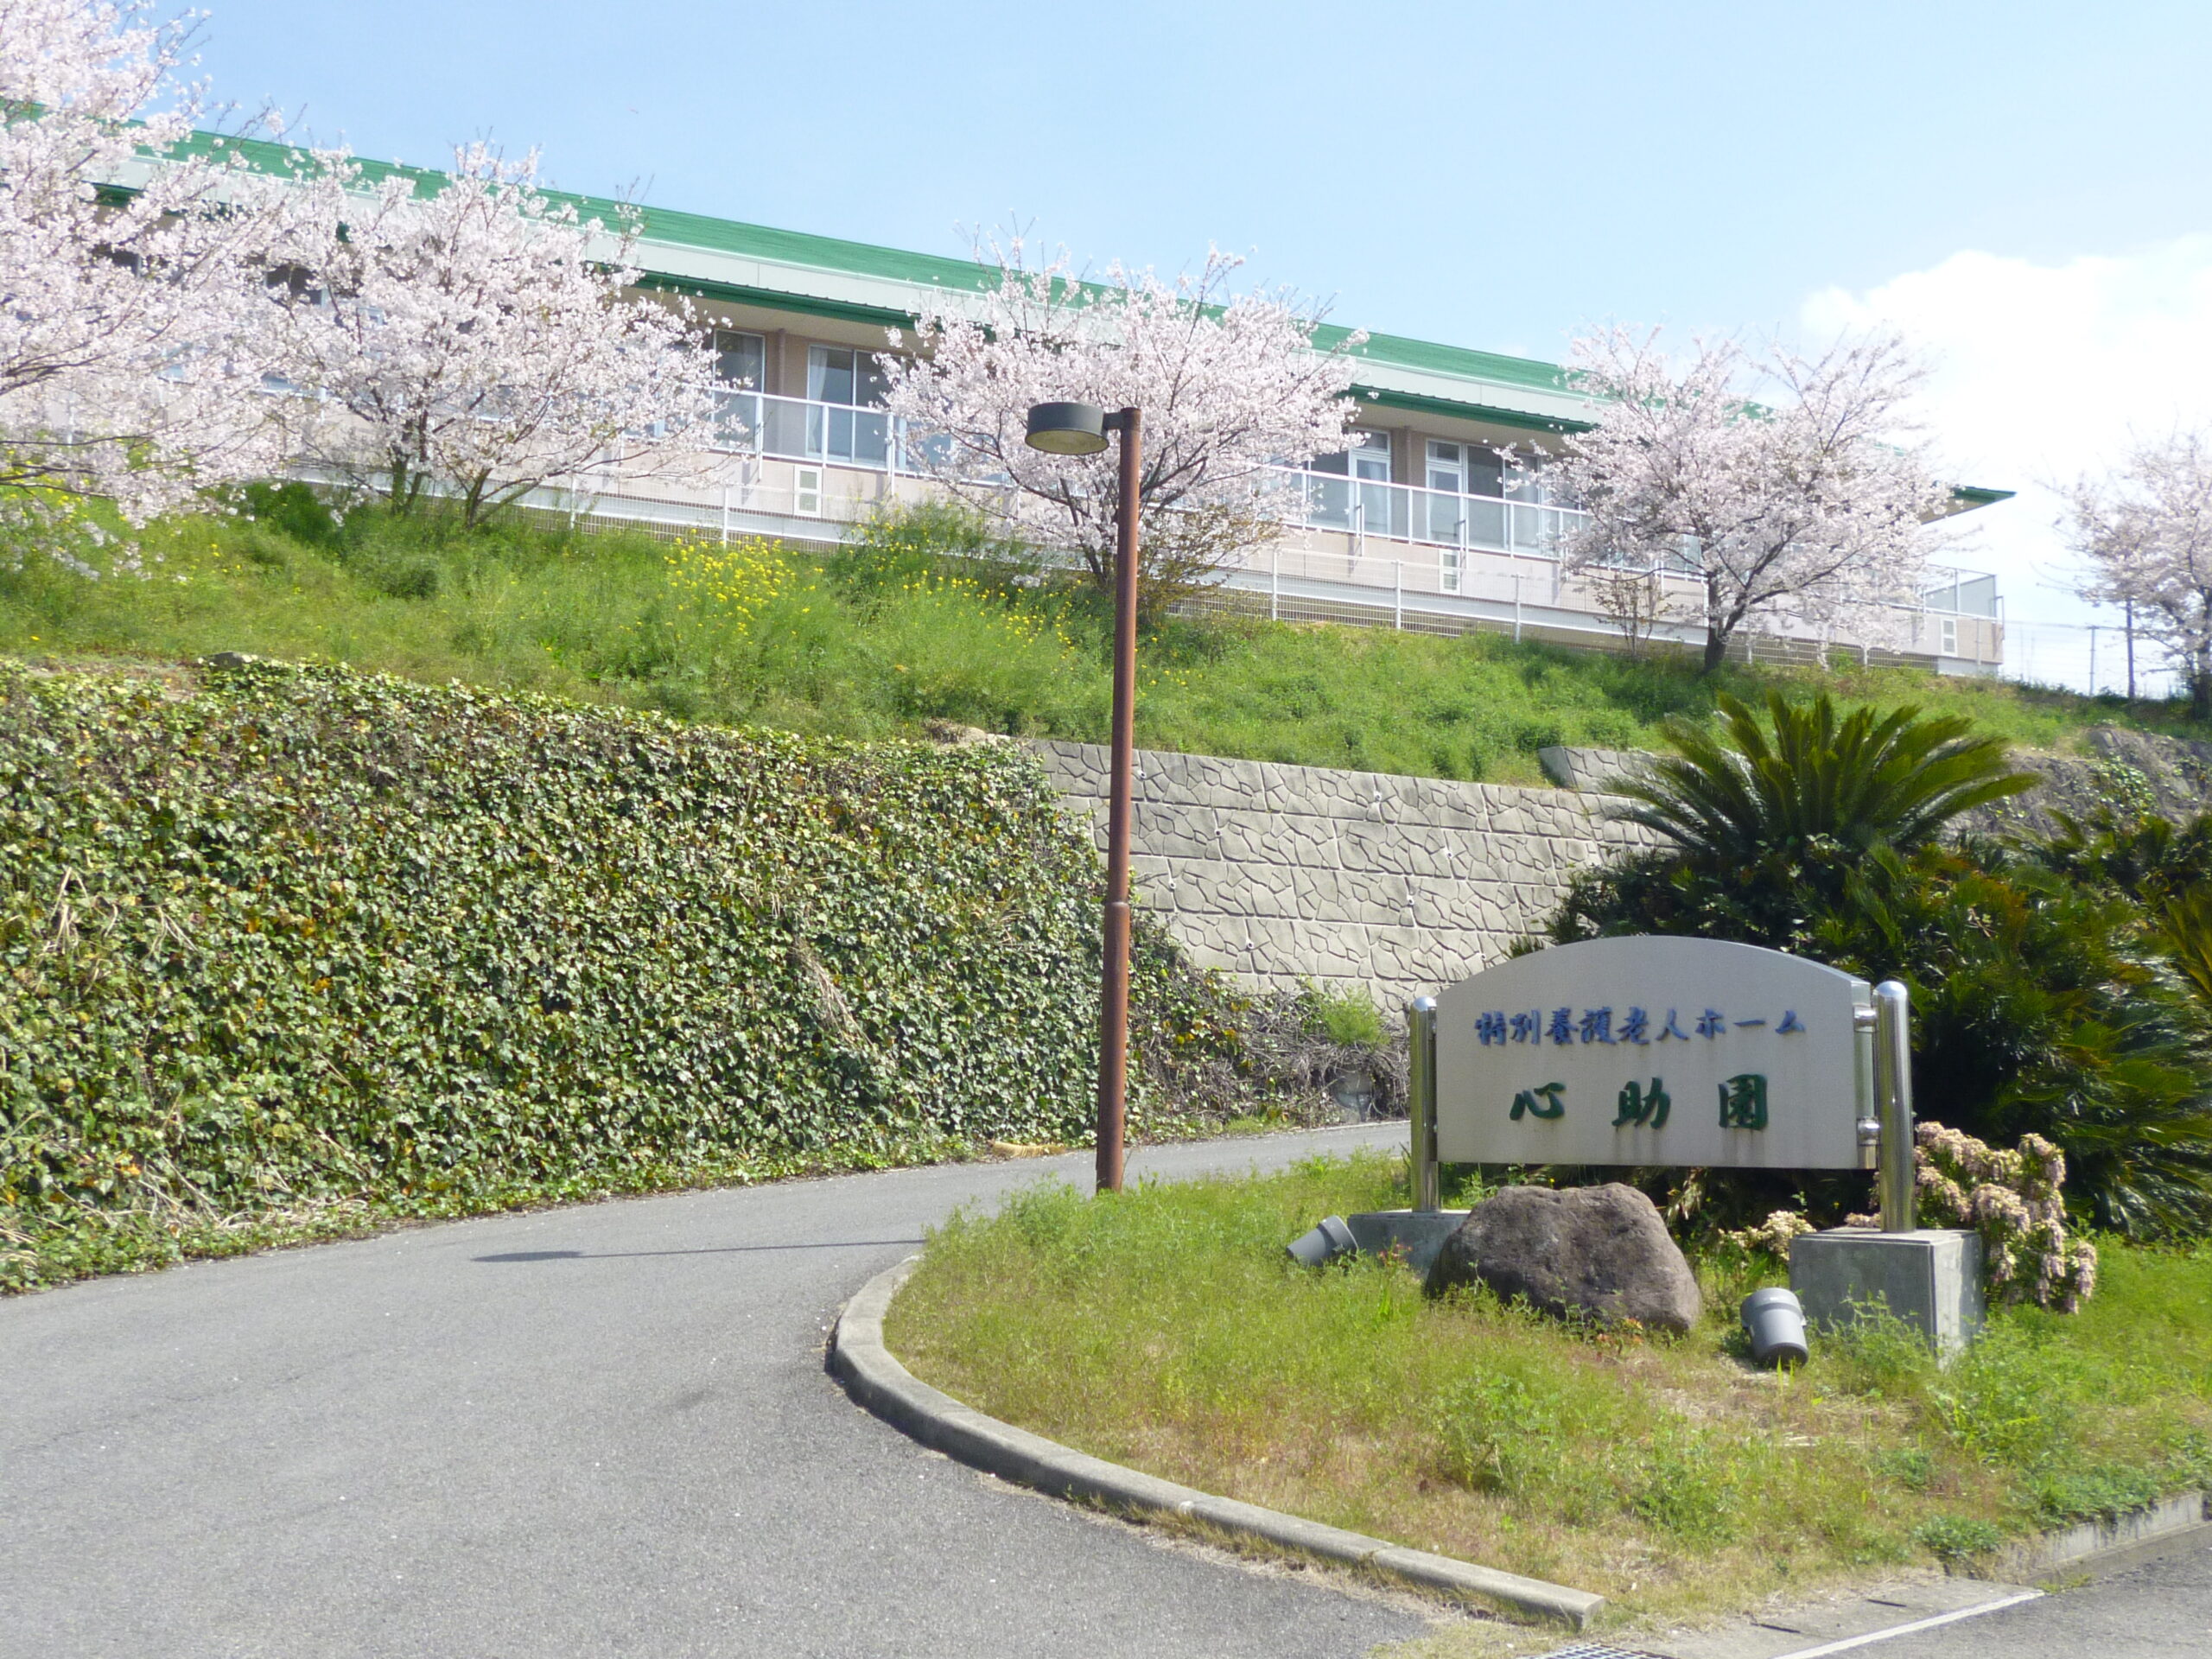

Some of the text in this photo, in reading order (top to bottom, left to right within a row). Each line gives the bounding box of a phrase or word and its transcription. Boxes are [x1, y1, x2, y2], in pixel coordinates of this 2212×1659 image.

[1475, 1007, 1805, 1046] 特別養護老人ホーム
[1509, 1073, 1768, 1130] 心助園
